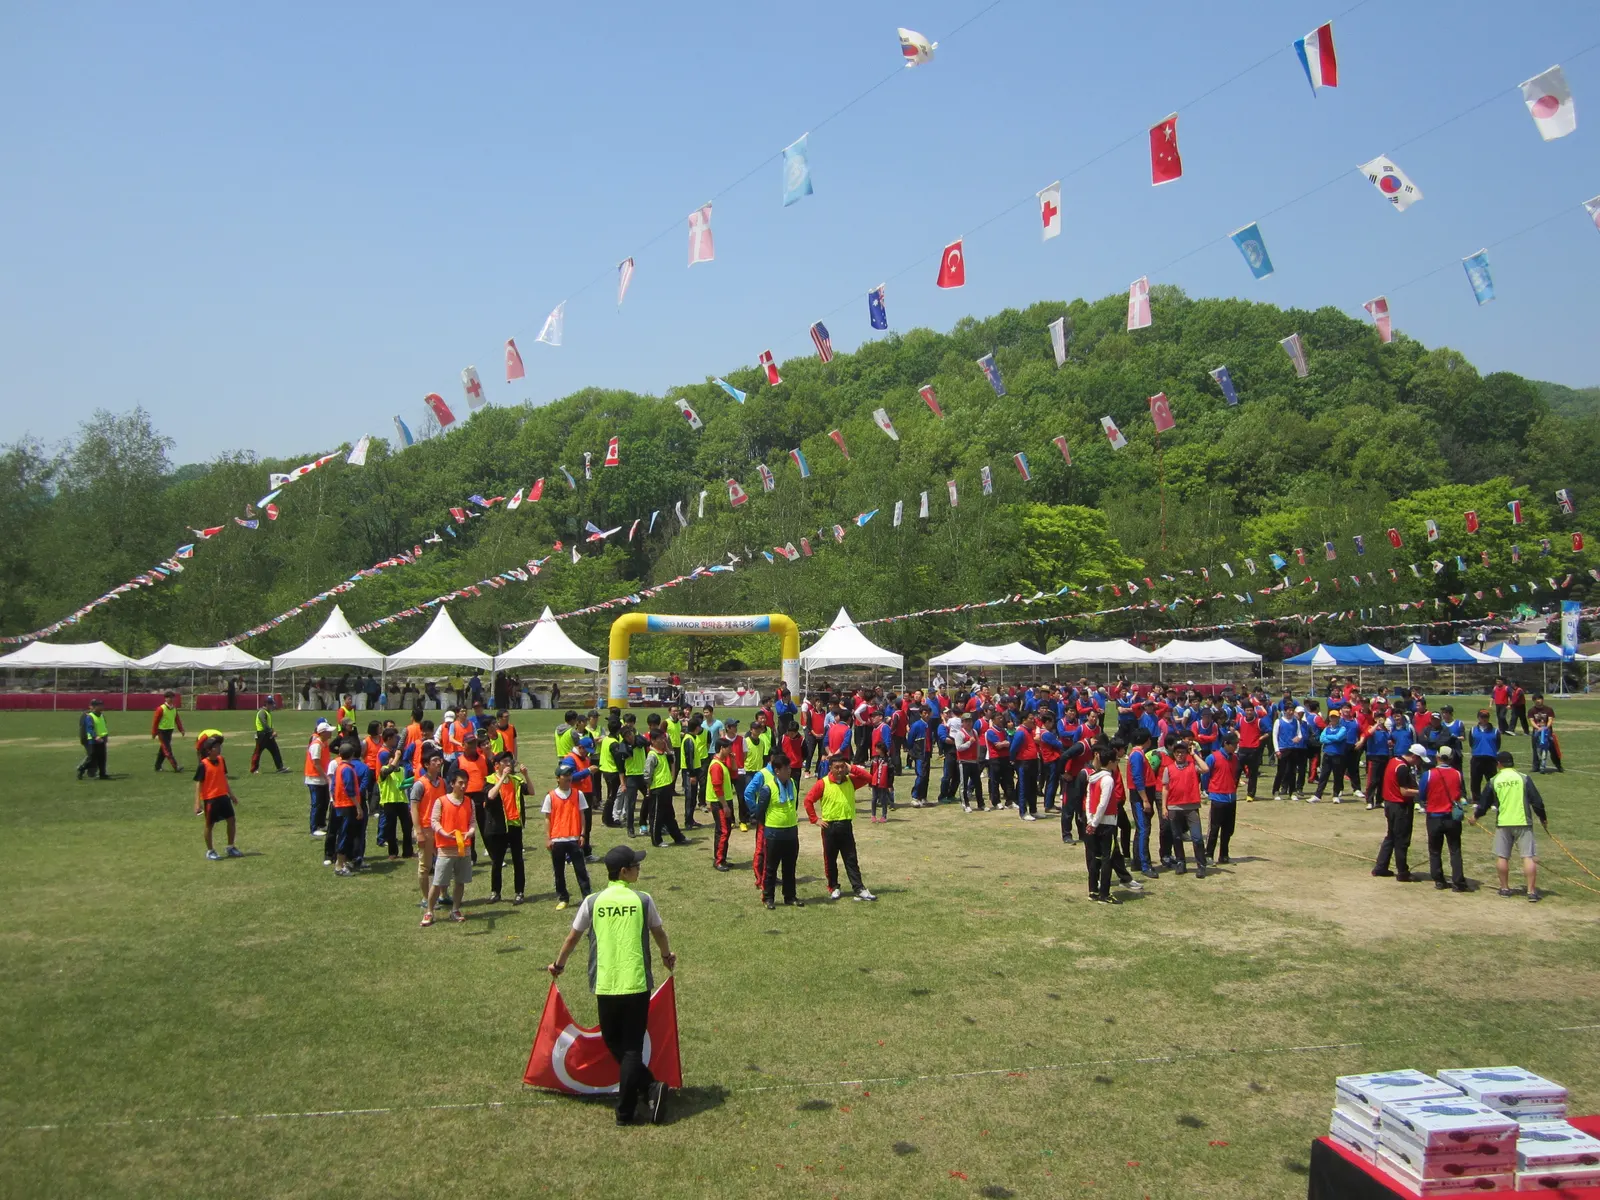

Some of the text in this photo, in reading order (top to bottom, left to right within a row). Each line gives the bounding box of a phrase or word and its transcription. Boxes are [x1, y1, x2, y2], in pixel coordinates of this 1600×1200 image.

[677, 621, 700, 629] MKOR
[1497, 779, 1520, 789] STAFF
[598, 906, 637, 918] STAFF
